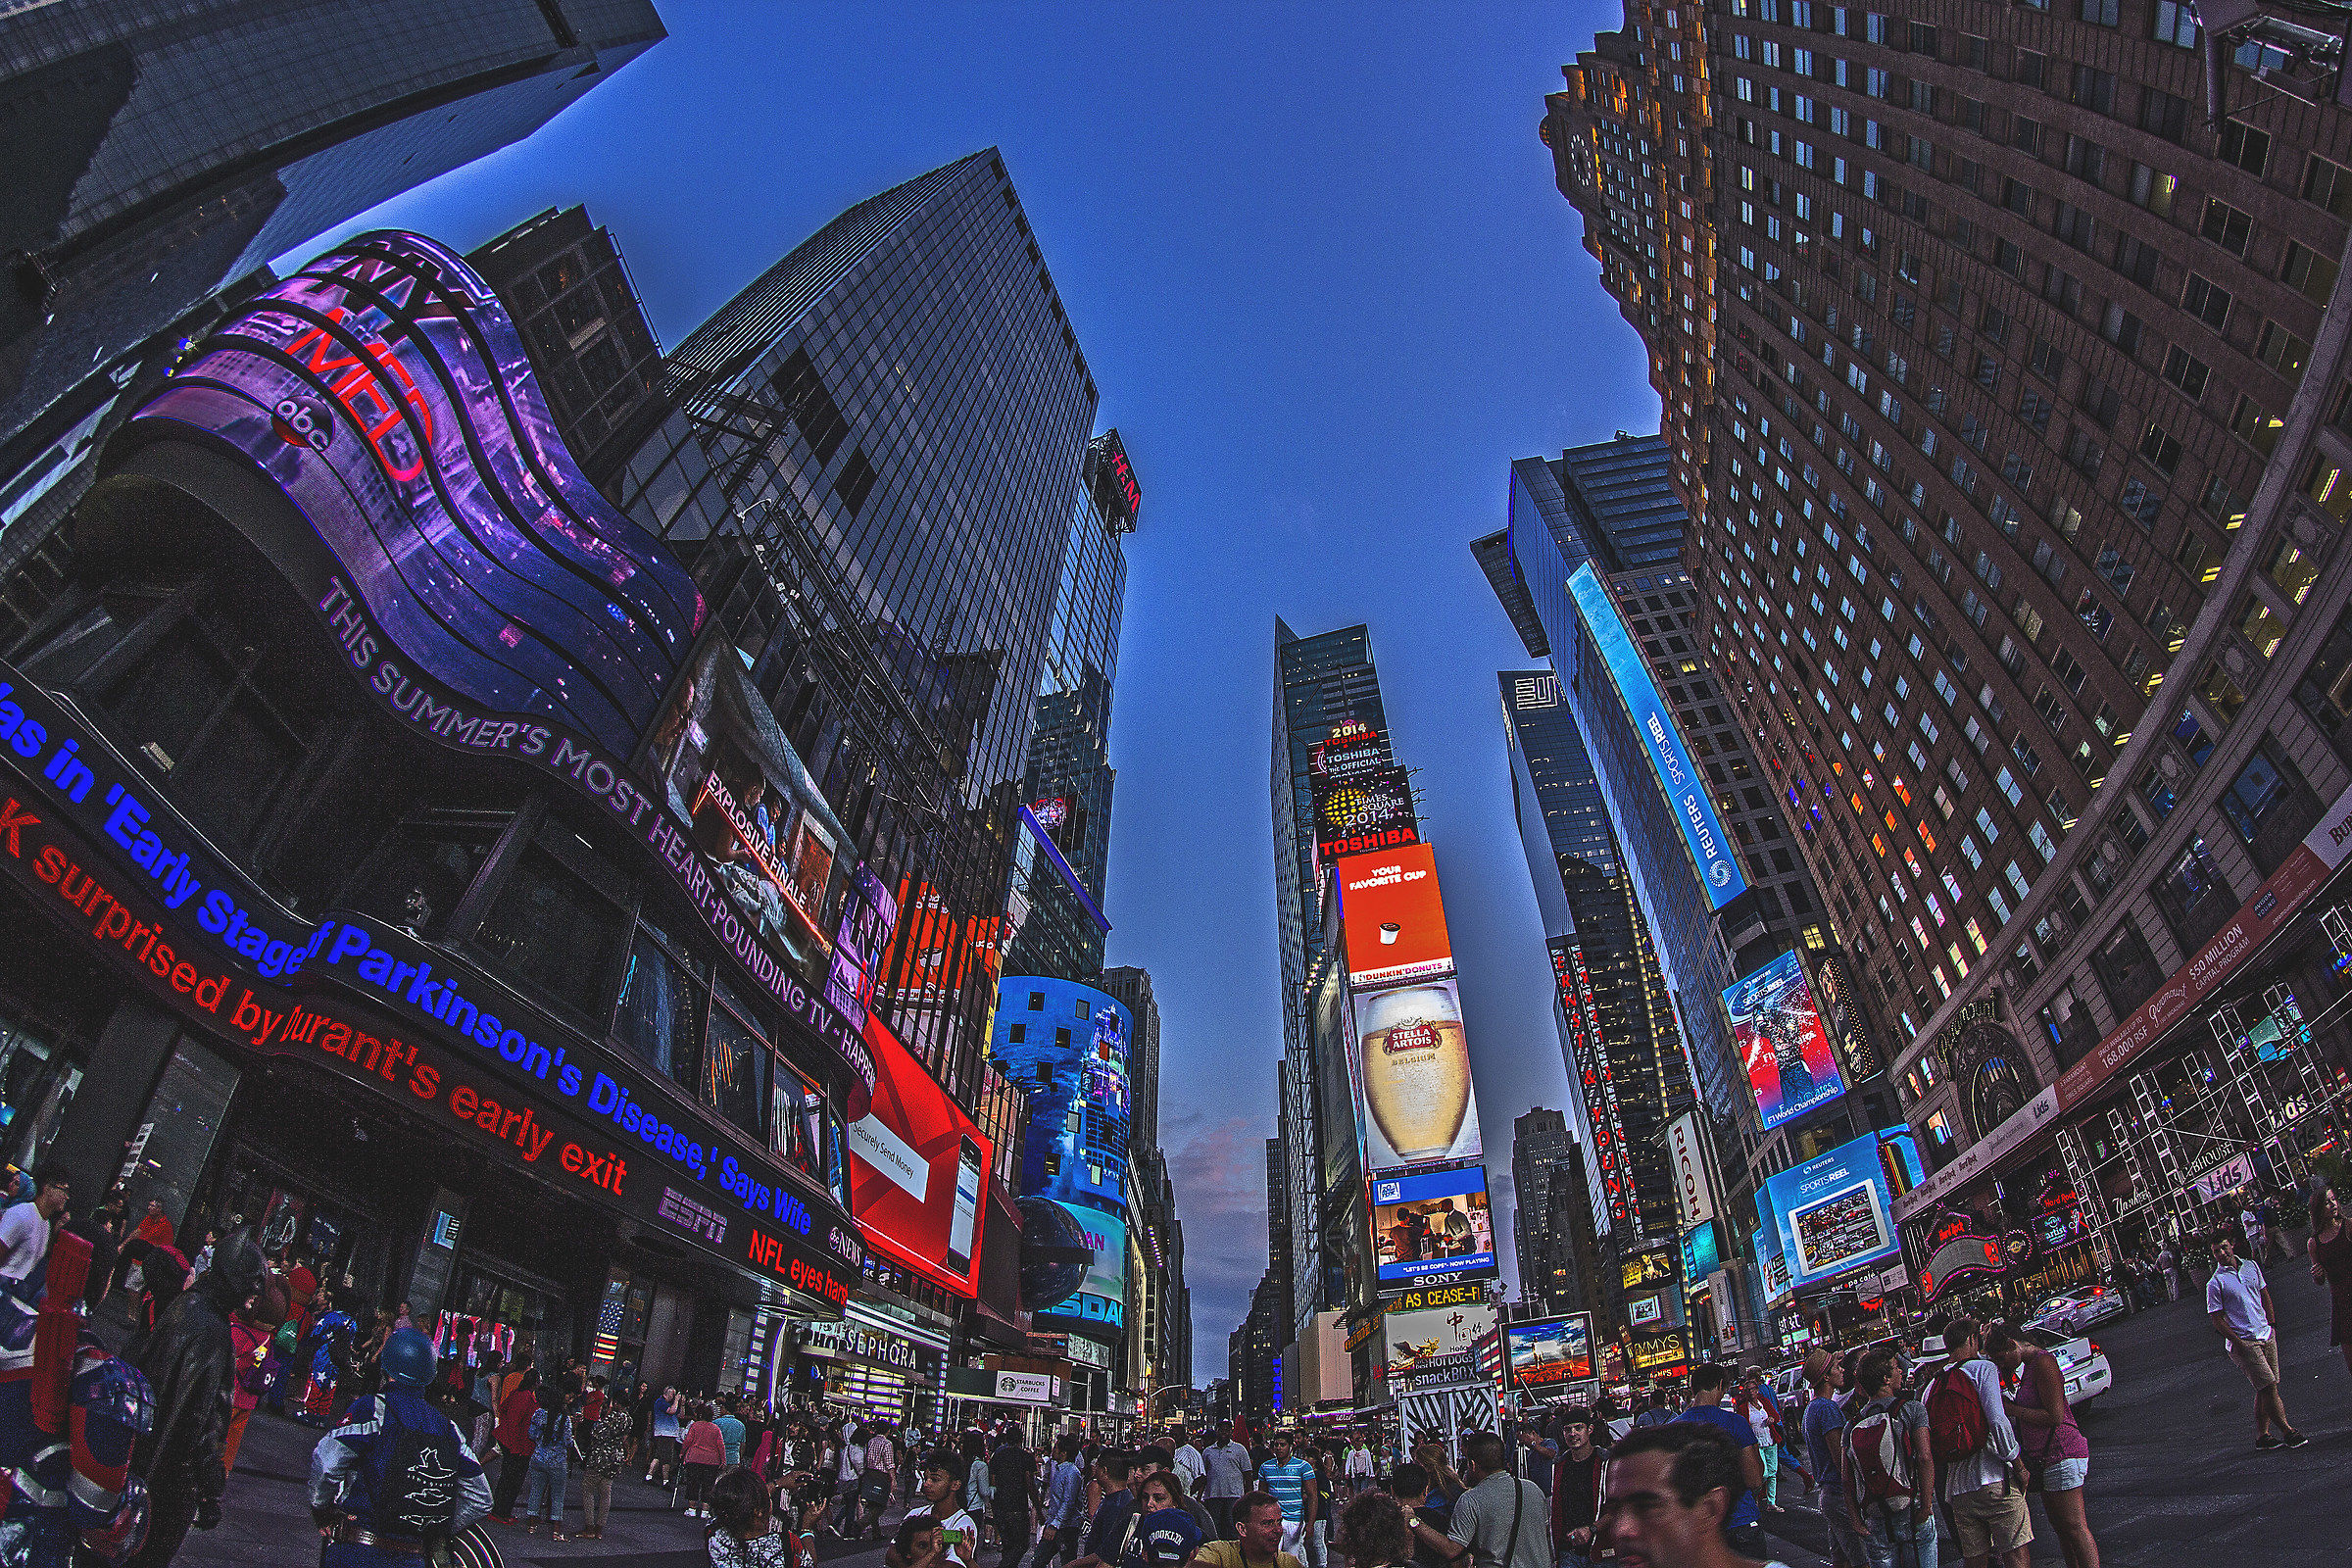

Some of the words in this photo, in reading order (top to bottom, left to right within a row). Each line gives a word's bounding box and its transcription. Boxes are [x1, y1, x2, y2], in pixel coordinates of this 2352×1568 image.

[284, 308, 433, 480] MED
[276, 400, 328, 452] abc
[1111, 450, 1141, 514] H&M
[1324, 730, 1379, 747] TOSHIBA
[1332, 722, 1367, 739] 2014
[1327, 748, 1380, 764] TOSHIBA
[1340, 758, 1382, 771] OFFICIAL
[318, 577, 379, 667] THIS
[370, 659, 552, 755] SUMMER'S
[550, 738, 654, 827] MOST
[651, 812, 807, 1013] HEART-POUNDING
[807, 1000, 833, 1034] TV
[1354, 793, 1389, 807] TIMES
[1362, 798, 1405, 812] SQUARE
[1345, 808, 1391, 827] 2014
[1684, 794, 1718, 859] REUTERS
[707, 769, 771, 861] EXPLOSIVE
[769, 855, 808, 909] FINALE
[1319, 827, 1417, 857] TOSHIBA
[1348, 874, 1402, 891] FAVORITE
[1403, 870, 1427, 881] CUP
[1371, 865, 1402, 877] YOUR
[0, 682, 47, 758] as
[44, 738, 95, 804] in
[104, 783, 201, 909] 'Early
[326, 923, 583, 1097] Parkinson's
[719, 1155, 771, 1214] Says
[771, 1186, 811, 1236] Wife
[2188, 961, 2206, 980] $50
[2205, 923, 2243, 961] MILLION
[2195, 965, 2221, 991] CAPITAL
[2219, 936, 2250, 969] PROGRAM
[32, 845, 231, 1014] surprised
[230, 989, 283, 1046] by
[451, 1086, 555, 1162] early
[561, 1143, 627, 1197] exit
[1392, 1028, 1431, 1041] STELLA
[1393, 1036, 1432, 1050] ARTOIS
[2101, 1037, 2134, 1069] 168,000
[2133, 1025, 2149, 1045] RSF
[1556, 956, 1585, 1049] ERNST
[1585, 1069, 1596, 1085] &
[1592, 1106, 1626, 1219] YOUNG
[1793, 1086, 1838, 1113] Championship
[2033, 1099, 2049, 1119] Lids
[853, 1121, 881, 1152] Securely
[880, 1143, 896, 1163] Send
[895, 1153, 914, 1179] Money
[1812, 1156, 1835, 1170] REUTERS
[1673, 1125, 1701, 1221] RICOH
[2208, 1162, 2242, 1196] Lids
[2044, 1196, 2060, 1207] Hard
[2060, 1190, 2077, 1204] Rock
[657, 1186, 728, 1243] ESPN
[2044, 1225, 2068, 1241] artist
[748, 1229, 786, 1274] NFL
[790, 1258, 823, 1293] eyes
[838, 1231, 862, 1267] NEWS
[1465, 1256, 1490, 1265] PLAYING
[1413, 1272, 1462, 1287] SONY
[846, 1329, 916, 1369] SEPHORA
[1429, 1355, 1447, 1368] HOT
[1448, 1352, 1474, 1365] DOGS
[1016, 1378, 1046, 1388] STARBUCKS
[1020, 1385, 1040, 1394] COFFEE
